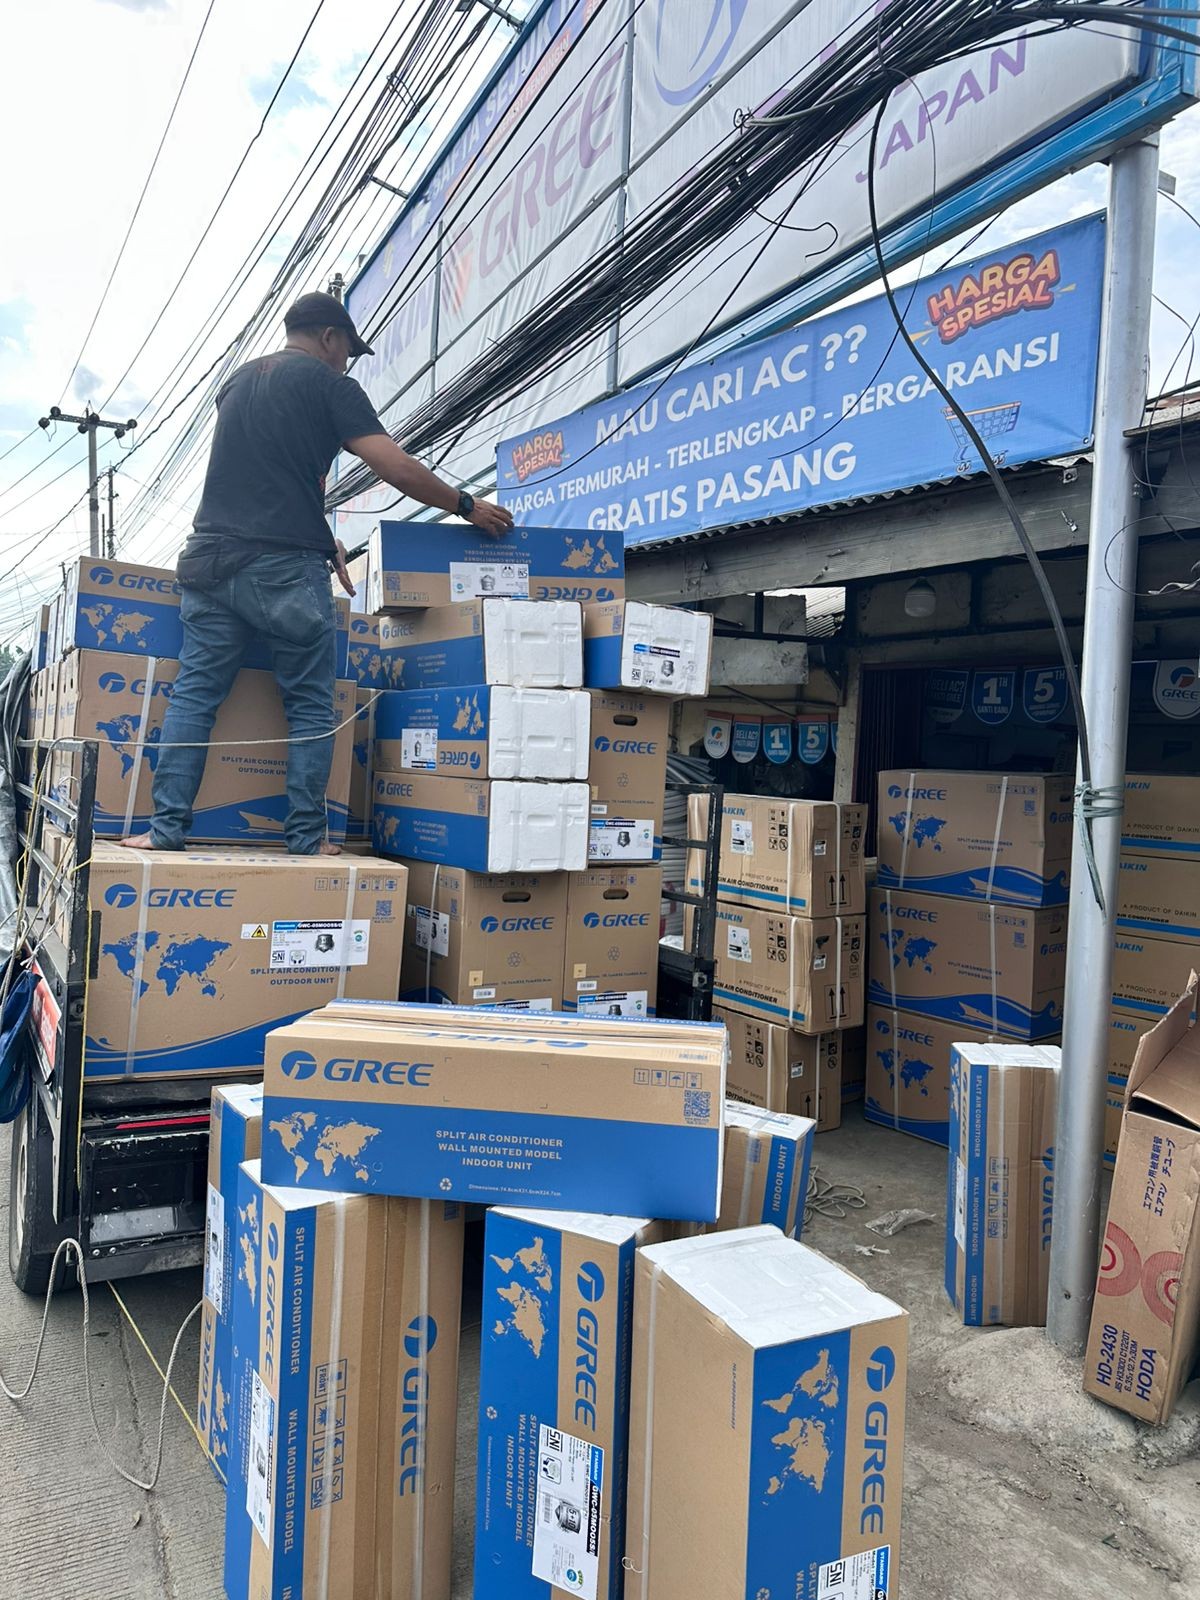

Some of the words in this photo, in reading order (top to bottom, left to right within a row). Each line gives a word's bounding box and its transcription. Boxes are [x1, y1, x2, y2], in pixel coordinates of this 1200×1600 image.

[479, 43, 625, 279] GREE
[929, 252, 1059, 323] HARGA
[939, 282, 1053, 343] SPESIAL
[595, 397, 659, 447] MAU
[666, 371, 744, 423] CARI
[739, 345, 808, 396] AC
[824, 324, 868, 372] ??
[503, 488, 555, 517] HARGA
[558, 456, 649, 502] TERMURAH
[667, 405, 815, 470] TERLENGKAP
[841, 332, 1060, 419] BERGARANSI
[513, 431, 563, 466] HARGA
[518, 449, 562, 480] SPESIAL
[587, 484, 687, 531] GRATIS
[696, 442, 857, 513] PASANG
[536, 586, 593, 600] GREE
[391, 623, 415, 638] GREE
[1033, 671, 1054, 703] 5
[612, 740, 658, 755] GREE
[806, 725, 820, 748] 5
[238, 767, 274, 775] OUTDOOR
[439, 751, 468, 766] GREE
[386, 782, 413, 798] GREE
[904, 787, 948, 801] GREE
[144, 888, 238, 908] GREE
[737, 880, 779, 892] CONDITIONER
[502, 916, 556, 932] GREE
[603, 913, 651, 928] GREE
[896, 905, 938, 923] GREE
[1130, 904, 1161, 912] PRODUCT
[1174, 908, 1197, 917] DAIKIN
[250, 967, 275, 975] SPLIT
[271, 952, 285, 962] SNI
[724, 983, 735, 992] AIR
[735, 986, 778, 1004] CONDITIONER
[1123, 993, 1166, 1005] CONDITIONER
[1126, 984, 1157, 995] PRODUCT
[895, 1028, 935, 1047] GREE
[323, 1059, 435, 1086] GREE
[975, 1074, 983, 1095] SPLIT
[436, 1130, 466, 1140] SPLIT
[468, 1132, 487, 1141] AIR
[488, 1134, 564, 1148] CONDITIONER
[974, 1108, 982, 1158] CONDITIONER
[438, 1143, 467, 1153] WALL
[469, 1145, 522, 1157] MOUNTED
[524, 1149, 562, 1160] MODEL
[462, 1157, 504, 1169] INDOOR
[506, 1161, 533, 1171] UNIT
[777, 1144, 788, 1169] UNIT
[772, 1170, 785, 1212] INDOOR
[1154, 1182, 1168, 1217] エアコン
[972, 1197, 980, 1232] MOUNTED
[295, 1226, 305, 1262] SPLIT
[971, 1234, 979, 1257] MODEL
[294, 1265, 303, 1287] AIR
[263, 1265, 277, 1385] GREE
[291, 1289, 303, 1375] CONDITIONER
[1096, 1323, 1119, 1387] HD-2430
[1114, 1381, 1123, 1393] JIS
[1119, 1330, 1130, 1359] C1220T
[318, 1367, 327, 1392] FRONT
[575, 1307, 600, 1432] GREE
[1136, 1348, 1157, 1402] HODA
[287, 1409, 298, 1444] WALL
[400, 1367, 429, 1497] GREE
[518, 1413, 527, 1444] WALL
[529, 1413, 538, 1447] SPLIT
[549, 1428, 563, 1453] SNI
[506, 1434, 514, 1478] INDOOR
[528, 1448, 537, 1468] AIR
[860, 1400, 890, 1537] GREE
[285, 1446, 297, 1508] MOUNTED
[516, 1446, 526, 1501] MOUNTED
[505, 1480, 513, 1509] UNIT
[526, 1469, 537, 1548] CONDITIONER
[284, 1510, 295, 1555] MODEL
[515, 1503, 524, 1542] MODEL
[829, 1561, 843, 1588] SNI
